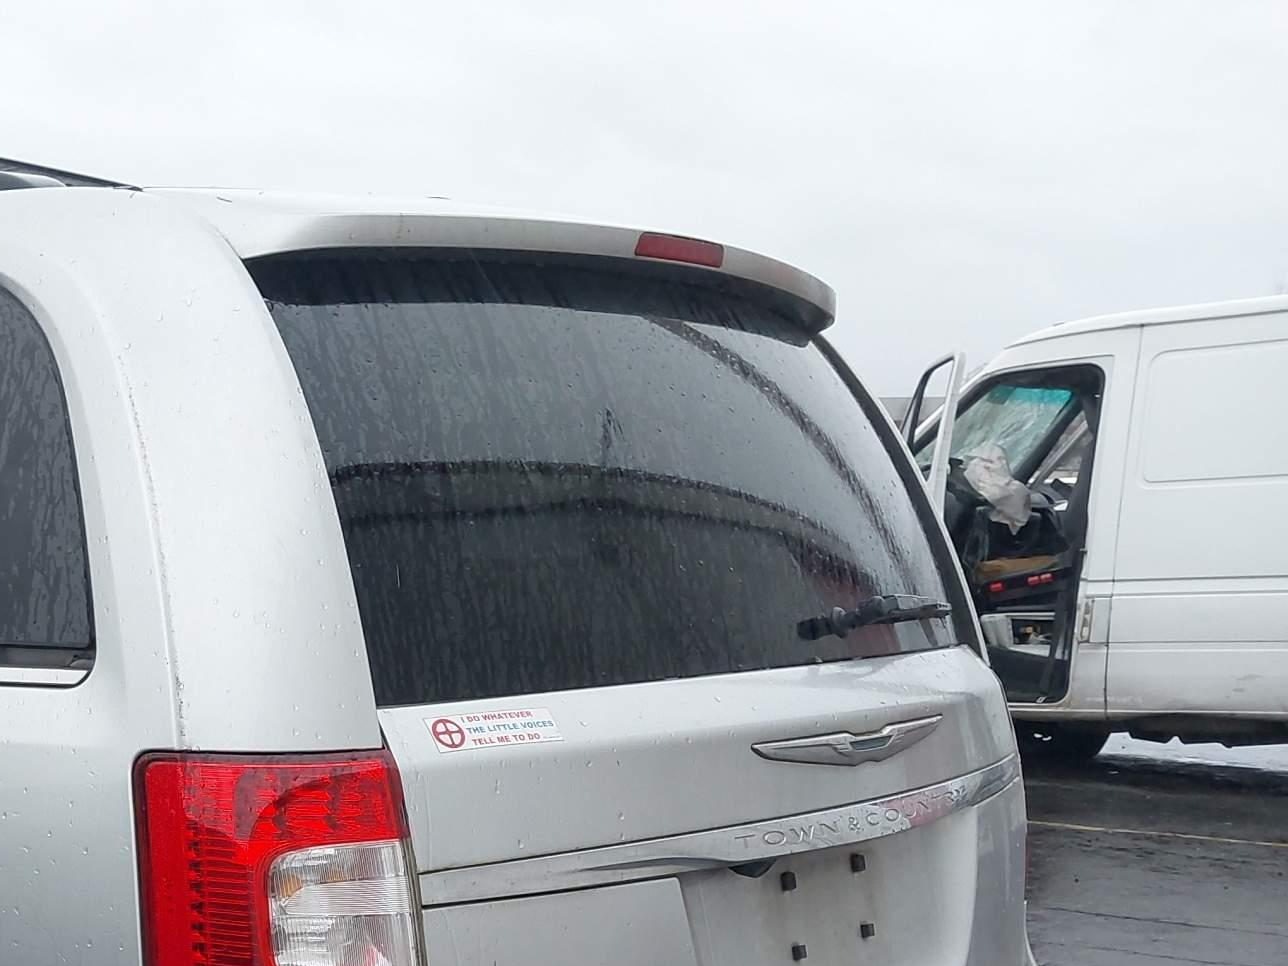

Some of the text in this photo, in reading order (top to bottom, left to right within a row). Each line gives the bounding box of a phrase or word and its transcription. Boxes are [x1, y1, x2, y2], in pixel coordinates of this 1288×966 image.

[481, 711, 533, 721] WHATEVER
[488, 723, 520, 732] LITTLE
[520, 720, 554, 729] VOICES
[472, 737, 495, 746] TELL
[496, 735, 511, 743] ME
